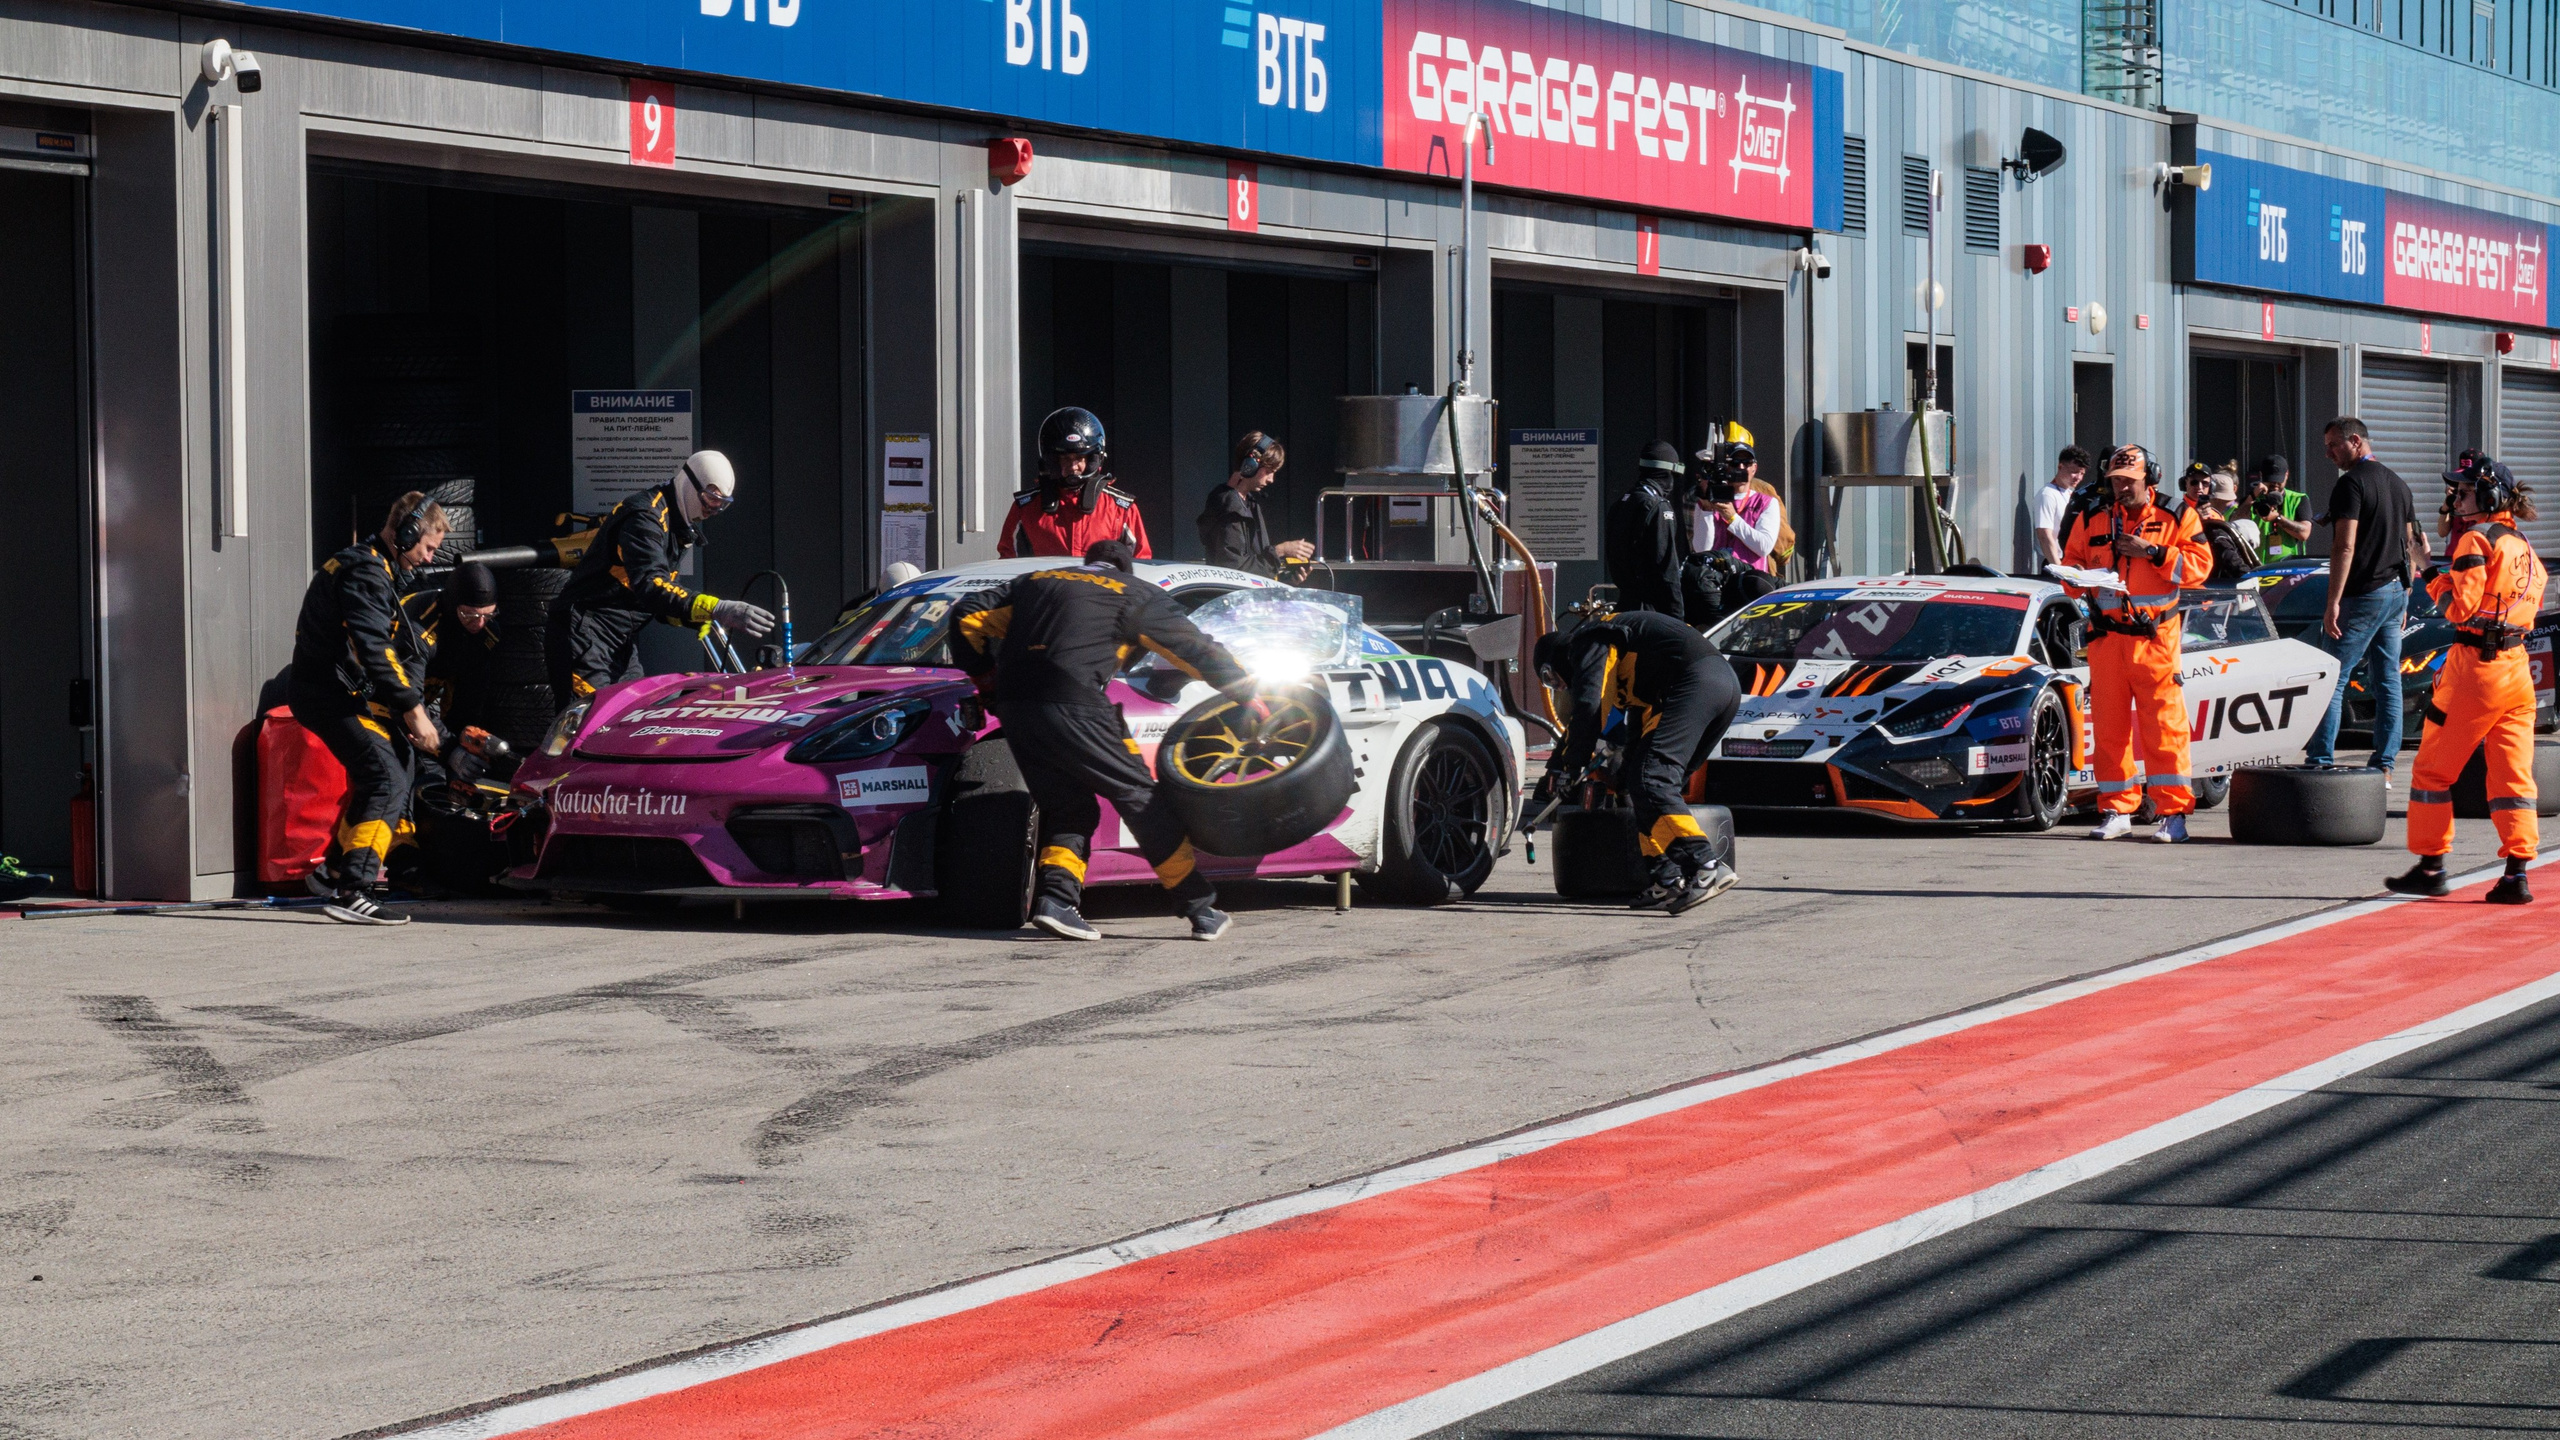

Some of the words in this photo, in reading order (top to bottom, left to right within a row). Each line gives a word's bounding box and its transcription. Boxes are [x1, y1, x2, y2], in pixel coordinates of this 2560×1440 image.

[1257, 12, 1328, 113] ВТБ
[643, 94, 662, 153] 9
[1236, 173, 1250, 221] 8
[1643, 224, 1653, 250] 7
[2260, 203, 2287, 264] ВТБ
[2341, 219, 2366, 276] ВТБ
[2265, 305, 2273, 335] 6
[2423, 327, 2430, 352] 5
[2552, 337, 2559, 360] 4
[590, 395, 675, 408] ВНИМАНИЕ
[589, 416, 625, 424] ПРАВИЛА
[627, 416, 674, 424] ПОВЕДЕНИЯ
[616, 424, 662, 432] ПИТ-ЛЕЙНЕ:
[1522, 432, 1586, 442] ВНИМАНИЕ
[2115, 453, 2137, 467] 222
[1739, 603, 1808, 620] 37
[1370, 639, 1390, 654] ВТБ
[1999, 716, 2022, 730] ВТБ
[1990, 753, 2027, 764] MARSHALL
[861, 778, 928, 793] MARSHALL
[553, 783, 688, 816] katusha-it.ru
